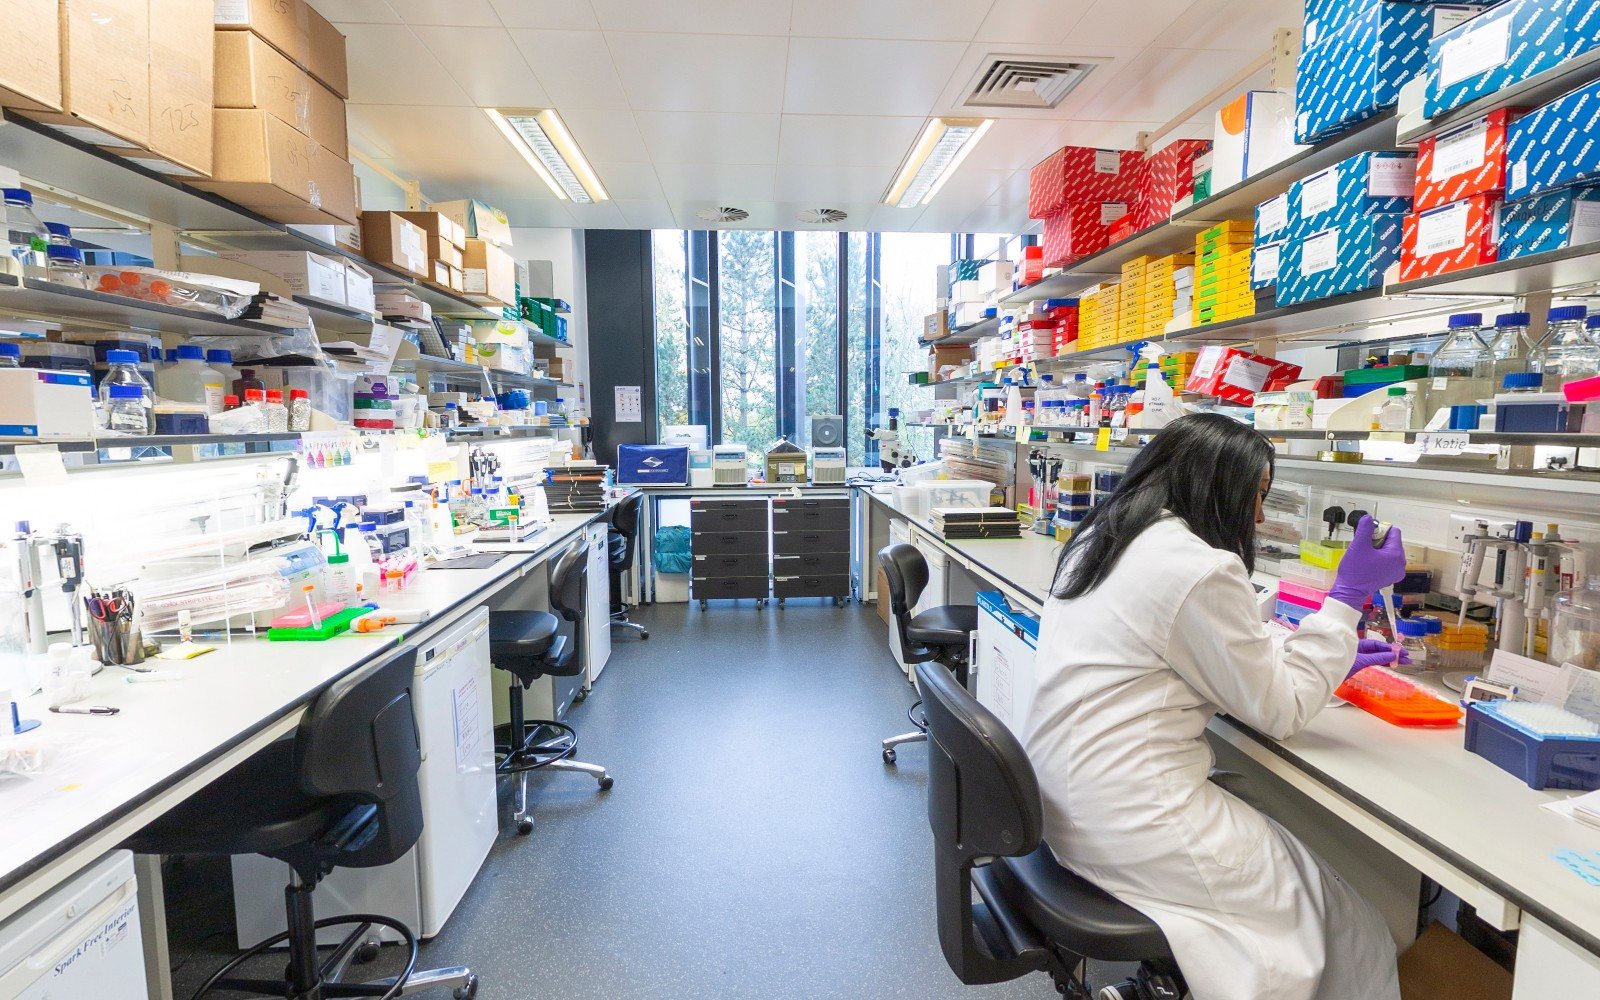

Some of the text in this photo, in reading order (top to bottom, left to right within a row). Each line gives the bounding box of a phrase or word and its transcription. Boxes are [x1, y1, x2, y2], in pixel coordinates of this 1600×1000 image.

[1518, 7, 1544, 36] QIAGEN
[1536, 16, 1562, 46] QIAGEN
[1402, 46, 1419, 64] QIAGEN
[1504, 42, 1528, 69] QIAGEN
[1520, 51, 1546, 79] QIAGEN
[1527, 107, 1548, 134] QIAGEN
[1567, 94, 1590, 122] QIAGEN
[1542, 117, 1562, 144] QIAGEN
[1557, 128, 1578, 155] QIAGEN
[1532, 150, 1550, 176] QIAGEN
[1573, 139, 1594, 166] QIAGEN
[1473, 161, 1494, 185] QIAGEN
[1546, 161, 1566, 186] QIAGEN
[1450, 179, 1469, 201] QIAGEN
[1501, 204, 1521, 227] QIAGEN
[1543, 198, 1566, 222] QIAGEN
[1380, 224, 1397, 240] QIAGEN
[1514, 216, 1536, 239] QIAGEN
[1529, 228, 1552, 251] QIAGEN
[1455, 242, 1474, 264] QIAGEN
[1435, 438, 1466, 449] Katie
[54, 904, 135, 976] Spark Free Interior
